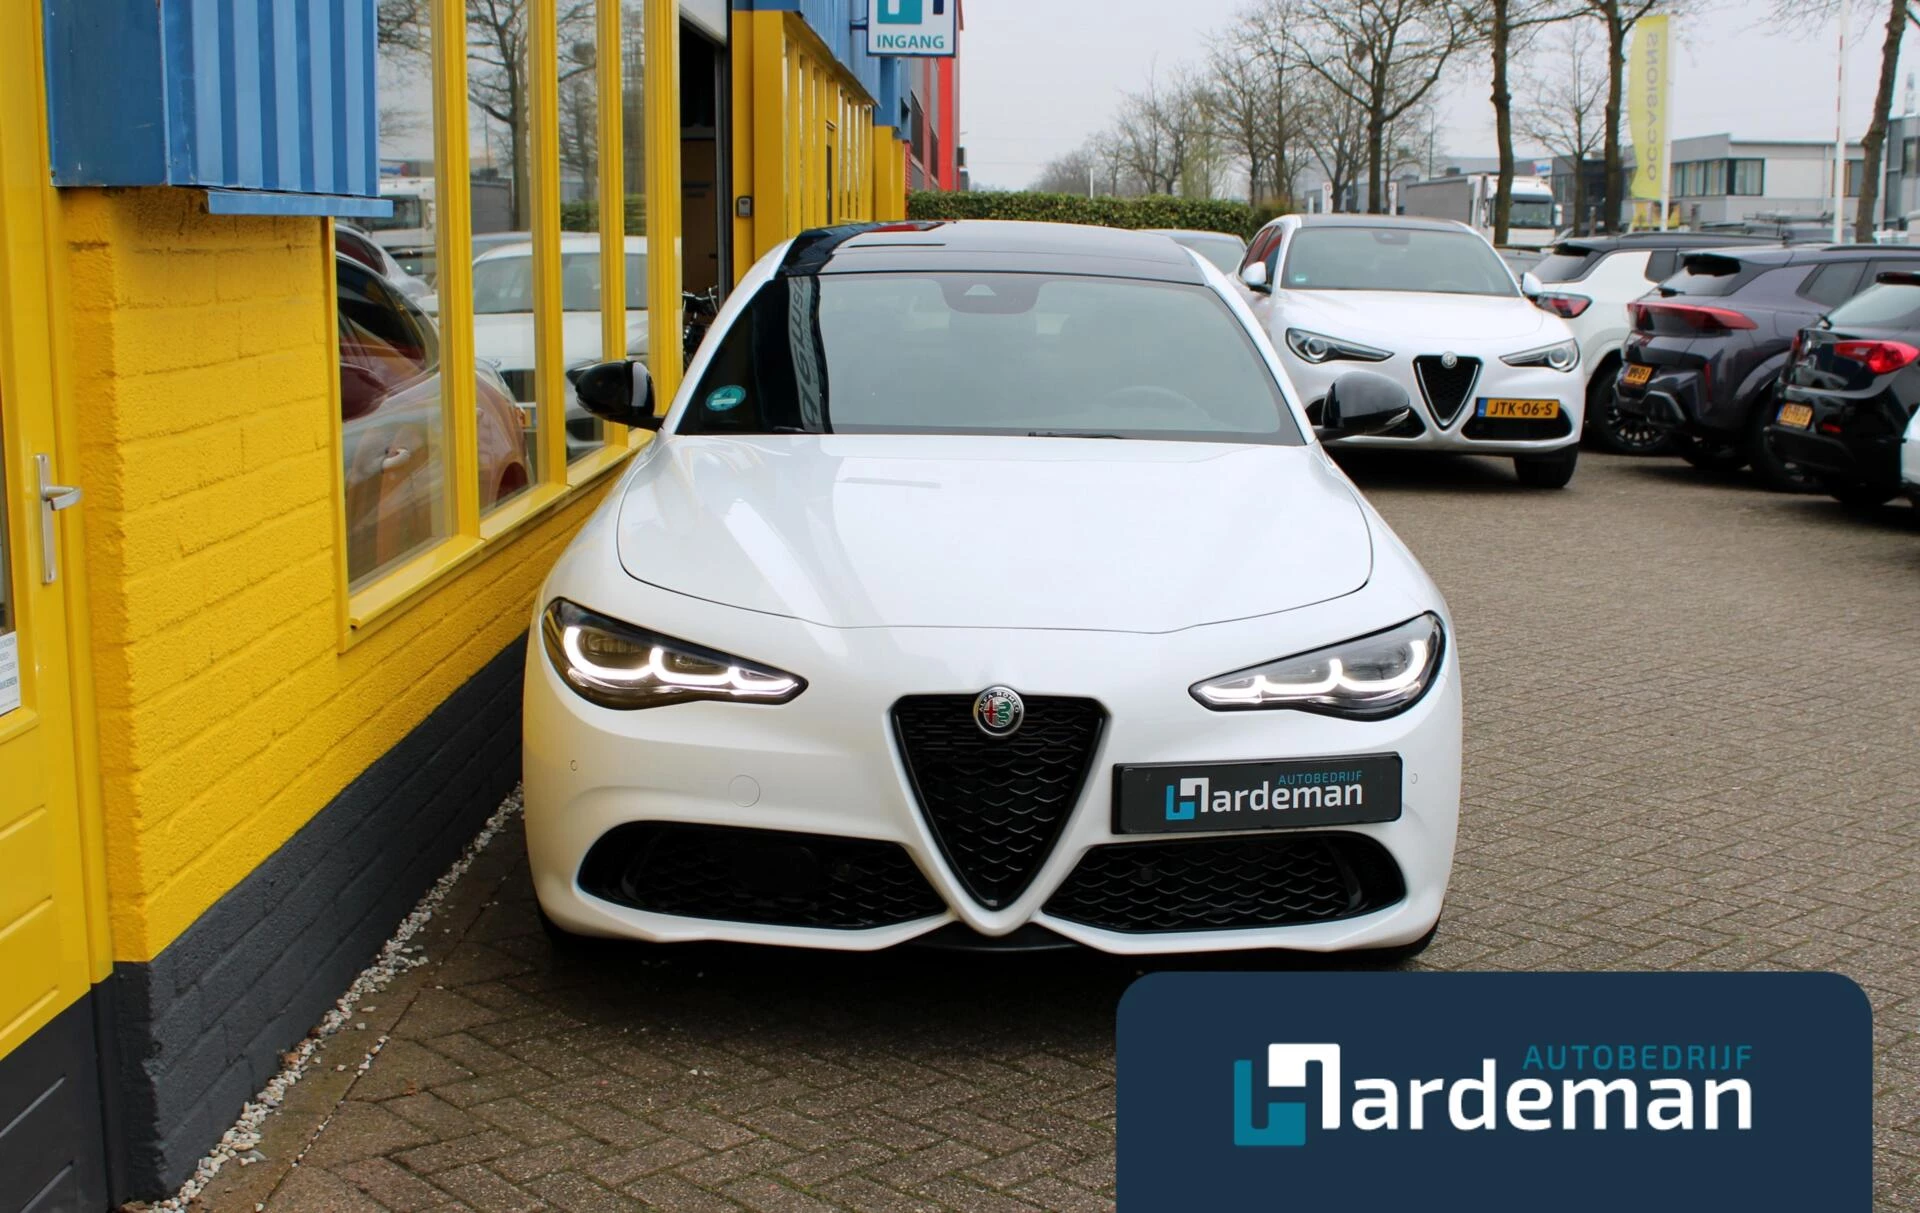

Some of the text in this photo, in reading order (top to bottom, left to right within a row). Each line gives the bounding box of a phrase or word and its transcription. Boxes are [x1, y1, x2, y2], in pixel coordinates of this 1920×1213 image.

[876, 34, 945, 49] INGANG
[1491, 402, 1553, 415] JTK-06-S
[1278, 770, 1362, 786] AUTOBEDRIJF
[1165, 777, 1363, 820] Hardeman
